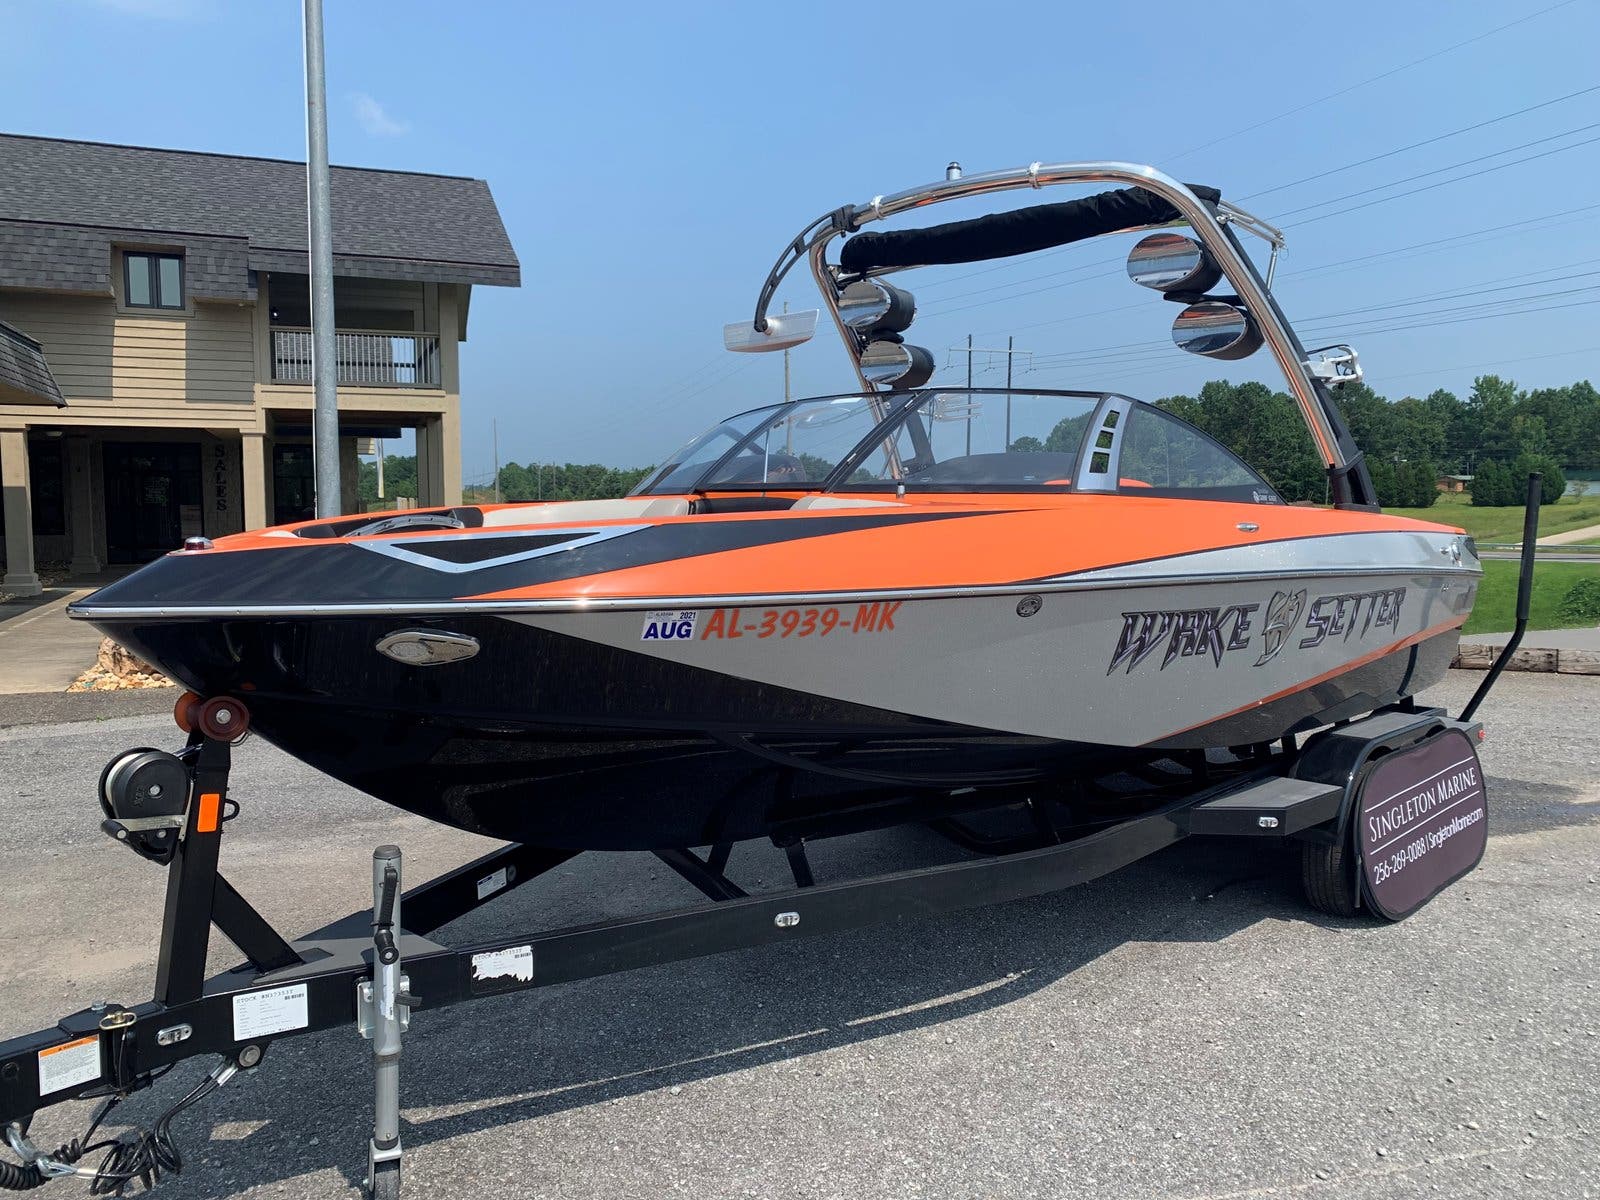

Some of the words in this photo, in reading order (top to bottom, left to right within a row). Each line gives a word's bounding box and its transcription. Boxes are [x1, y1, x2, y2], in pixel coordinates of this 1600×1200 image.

[214, 443, 227, 512] SALES
[643, 621, 692, 639] AUG
[680, 611, 697, 620] 2021
[699, 601, 902, 640] AL-3939-MK
[1107, 603, 1260, 676] WAKE
[1299, 587, 1406, 650] SETTER
[1369, 788, 1436, 843] SINGLETON
[1437, 767, 1477, 803] MARINE
[1373, 837, 1426, 885] 256-269-0088
